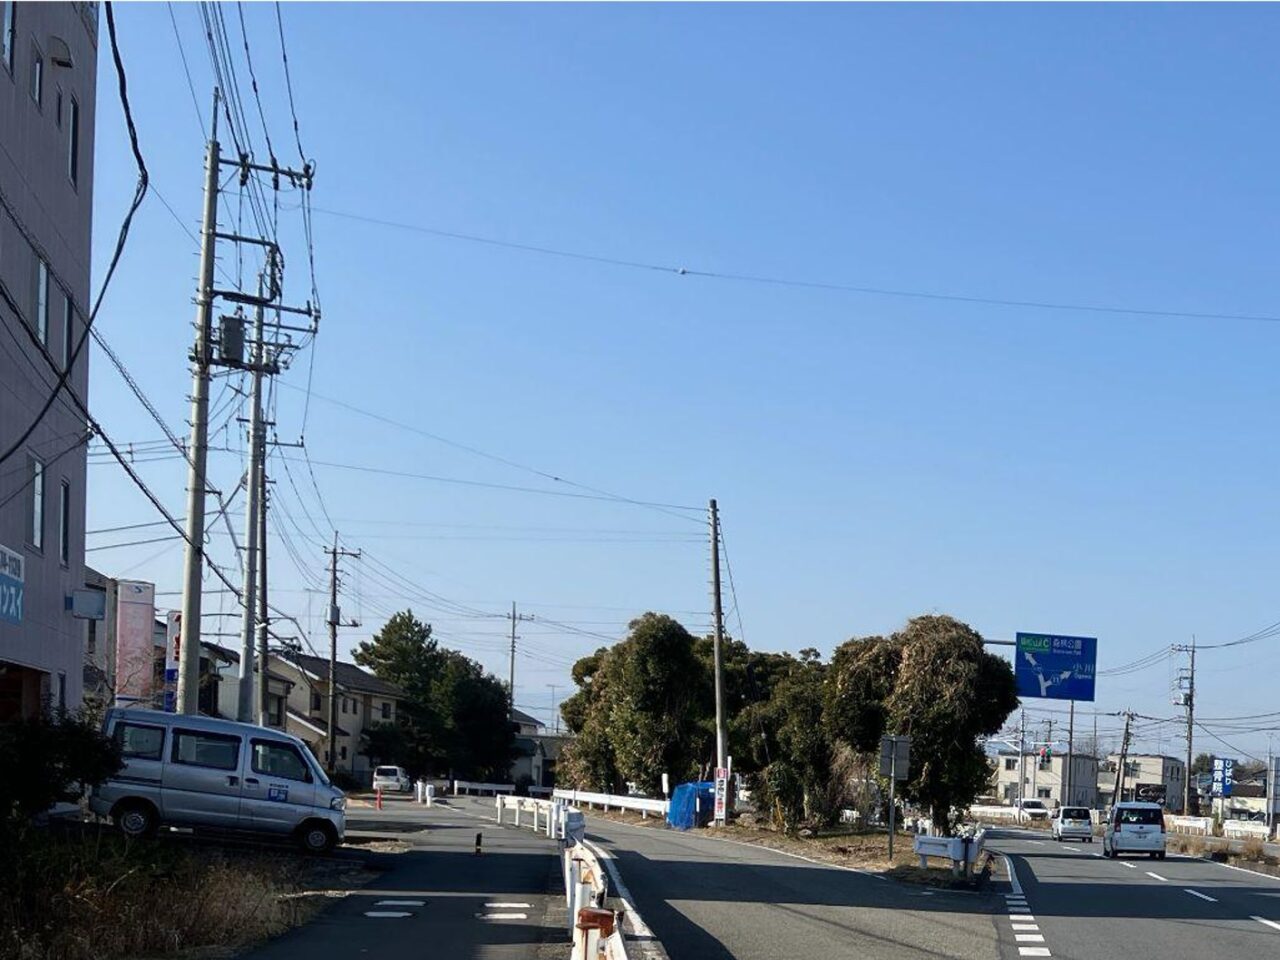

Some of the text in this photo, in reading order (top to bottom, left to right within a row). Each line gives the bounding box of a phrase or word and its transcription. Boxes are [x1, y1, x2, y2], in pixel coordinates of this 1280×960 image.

[0, 584, 23, 620] ンスイ
[1072, 663, 1094, 673] 小川
